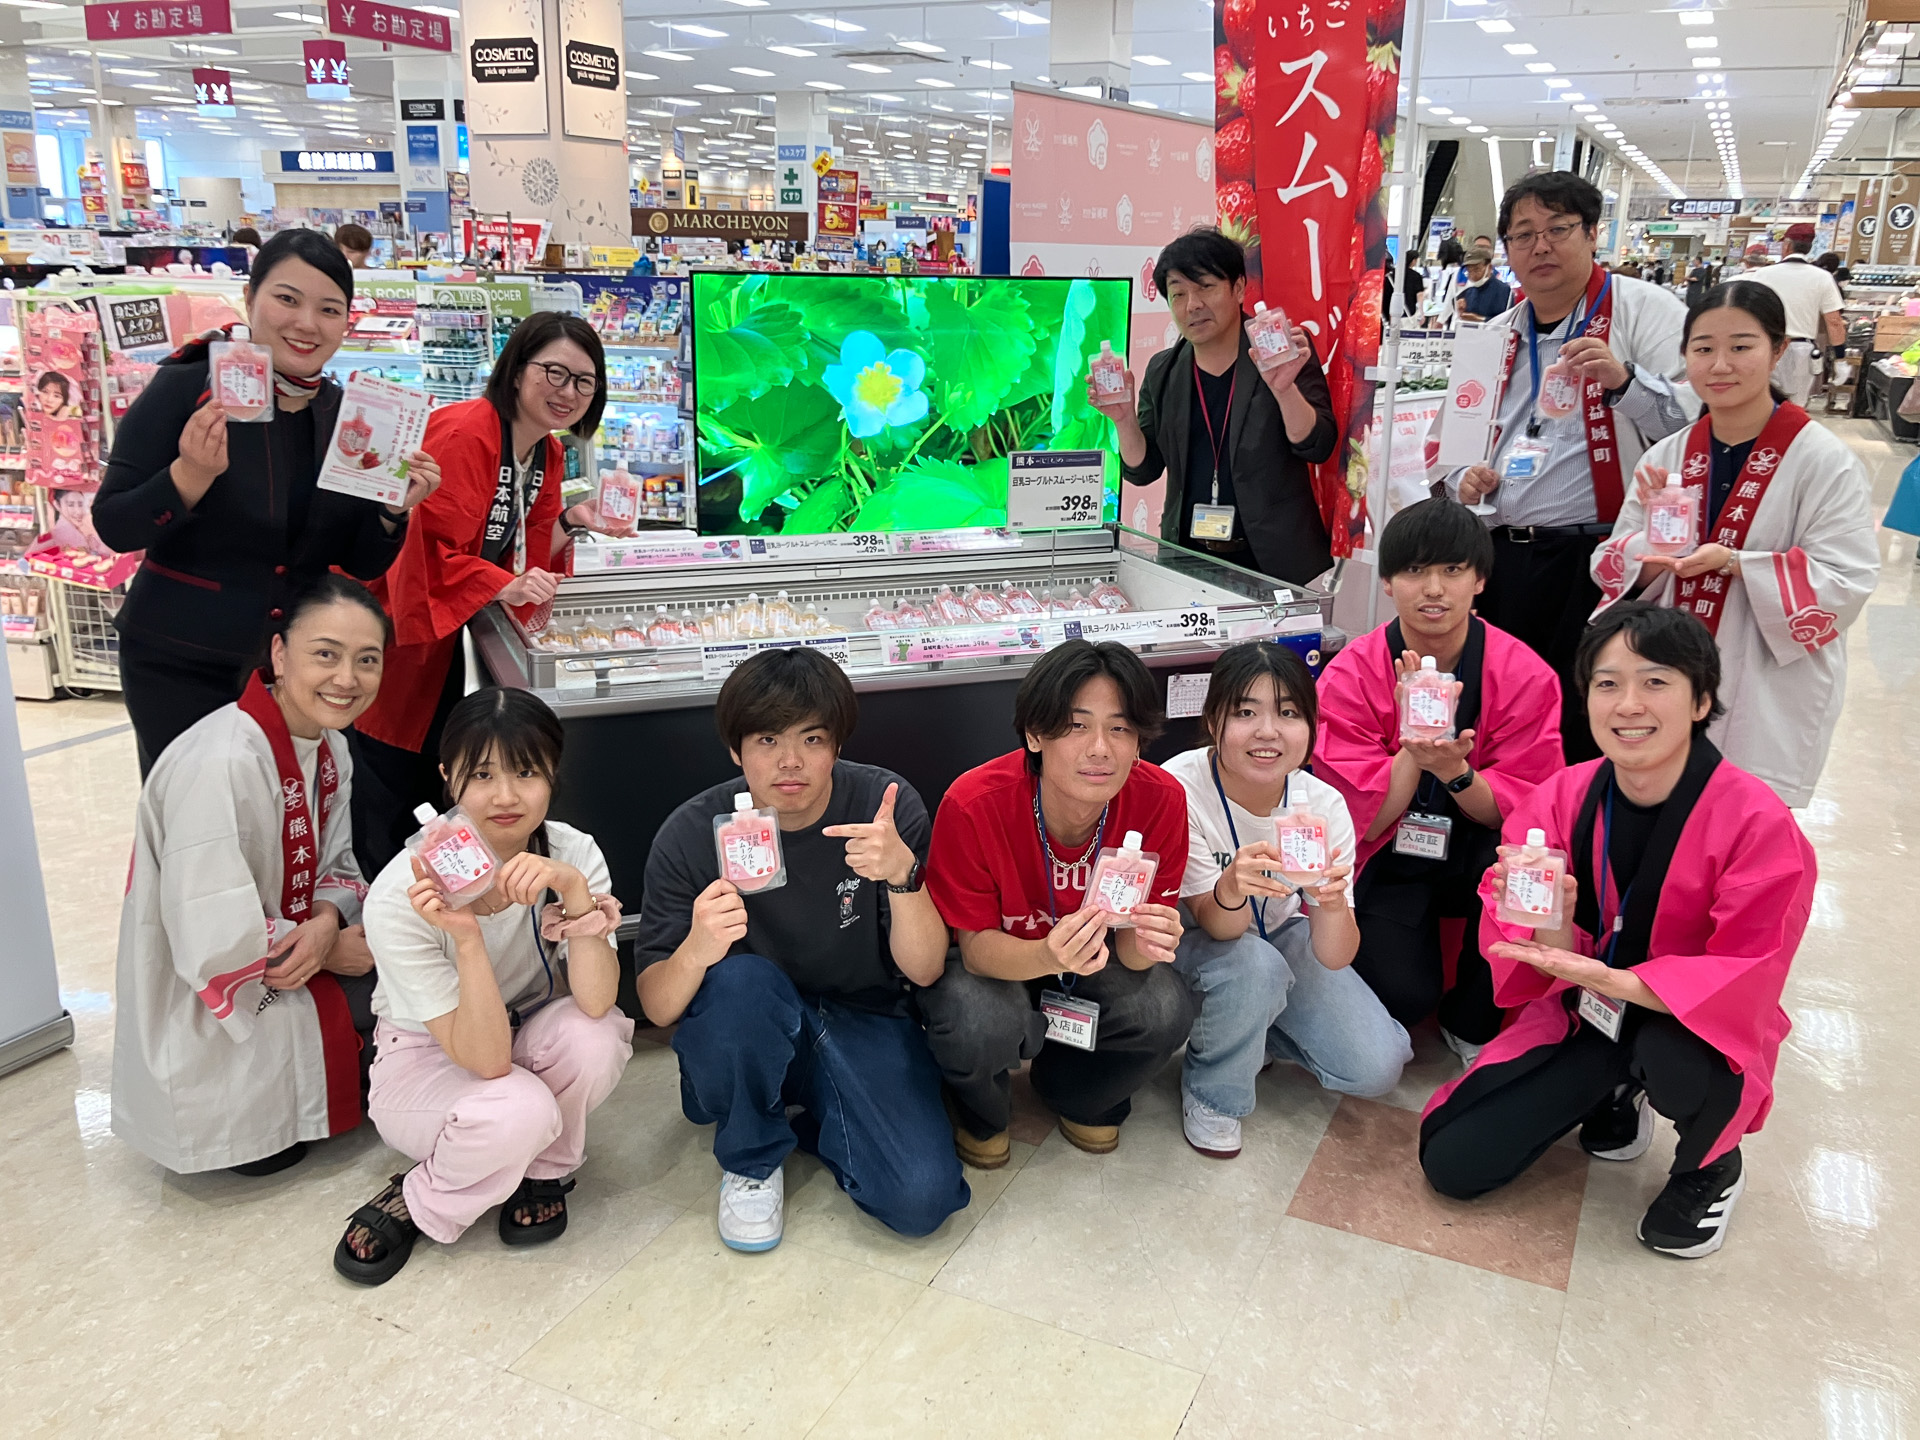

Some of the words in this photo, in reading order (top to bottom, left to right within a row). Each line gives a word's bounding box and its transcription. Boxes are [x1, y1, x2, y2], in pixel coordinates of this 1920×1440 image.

[133, 5, 203, 30] お勘定場
[1267, 0, 1350, 38] いちご
[371, 10, 444, 44] お勘定場
[475, 47, 534, 62] COSMETIC
[570, 50, 616, 70] COSMETIC
[484, 66, 498, 77] pick
[498, 69, 507, 77] up
[577, 70, 588, 80] pick
[780, 148, 806, 157] ヘルスケア
[782, 191, 800, 201] くすり
[1275, 50, 1348, 375] スムージ
[673, 213, 789, 231] MARCHEVON
[353, 287, 371, 298] ES
[375, 288, 416, 299] ROCH
[128, 317, 153, 333] メイク
[1587, 382, 1611, 462] 県益城町
[1012, 474, 1099, 487] 豆乳ヨーグルトスムージーいちご
[485, 466, 512, 541] 日本航空
[1061, 495, 1097, 511] 398円
[852, 534, 884, 547] 398円
[1082, 619, 1163, 634] 豆乳ヨーグルトスムージーいちご
[1180, 613, 1215, 628] 398円
[752, 834, 760, 847] 豆乳
[1402, 831, 1438, 846] 入店証
[739, 835, 747, 866] スムージー
[746, 835, 755, 869] ヨーグルトの
[288, 816, 312, 921] 熊本県益
[1583, 996, 1613, 1024] 入店証
[1048, 1016, 1085, 1035] 入店証
